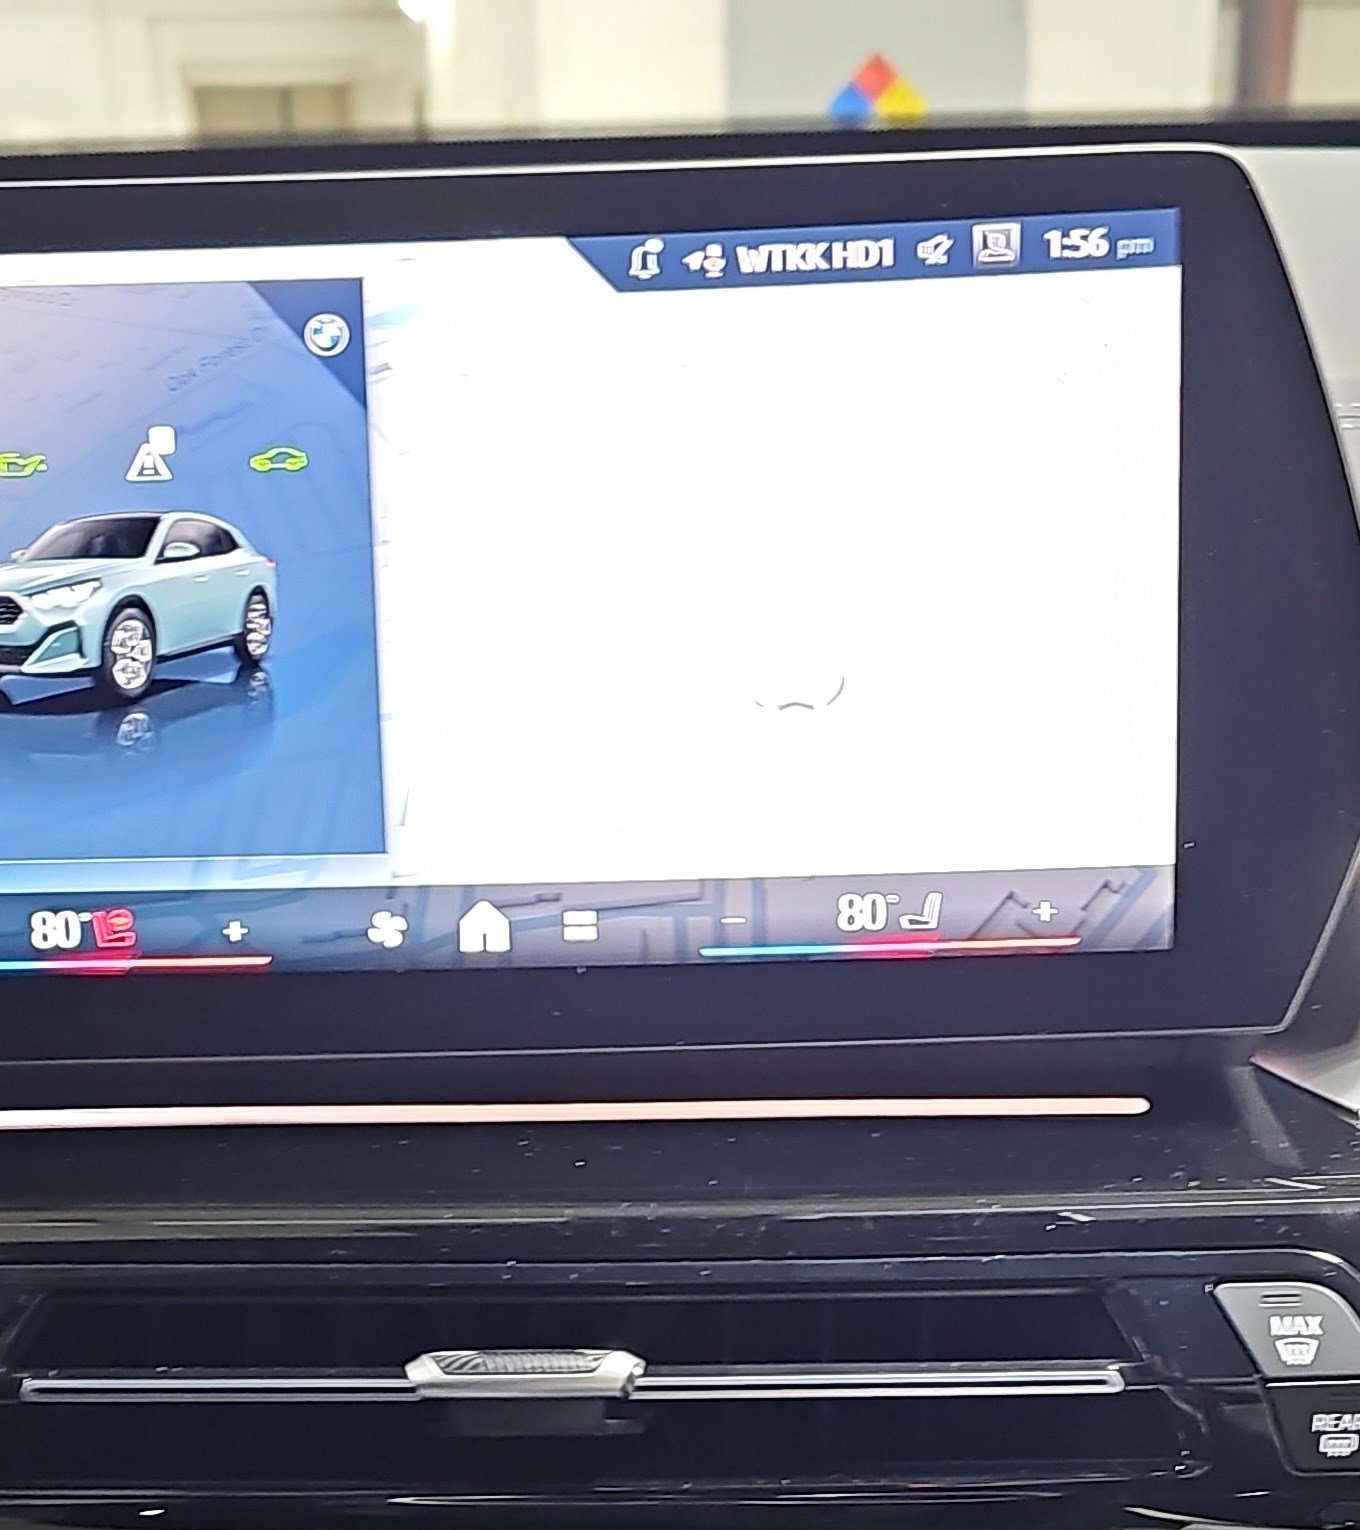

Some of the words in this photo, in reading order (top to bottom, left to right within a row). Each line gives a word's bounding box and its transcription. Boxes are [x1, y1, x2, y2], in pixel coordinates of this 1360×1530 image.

[735, 241, 830, 274] WTKK
[831, 237, 895, 270] HD1
[1042, 225, 1110, 260] 1:56
[1269, 1315, 1324, 1336] MAX
